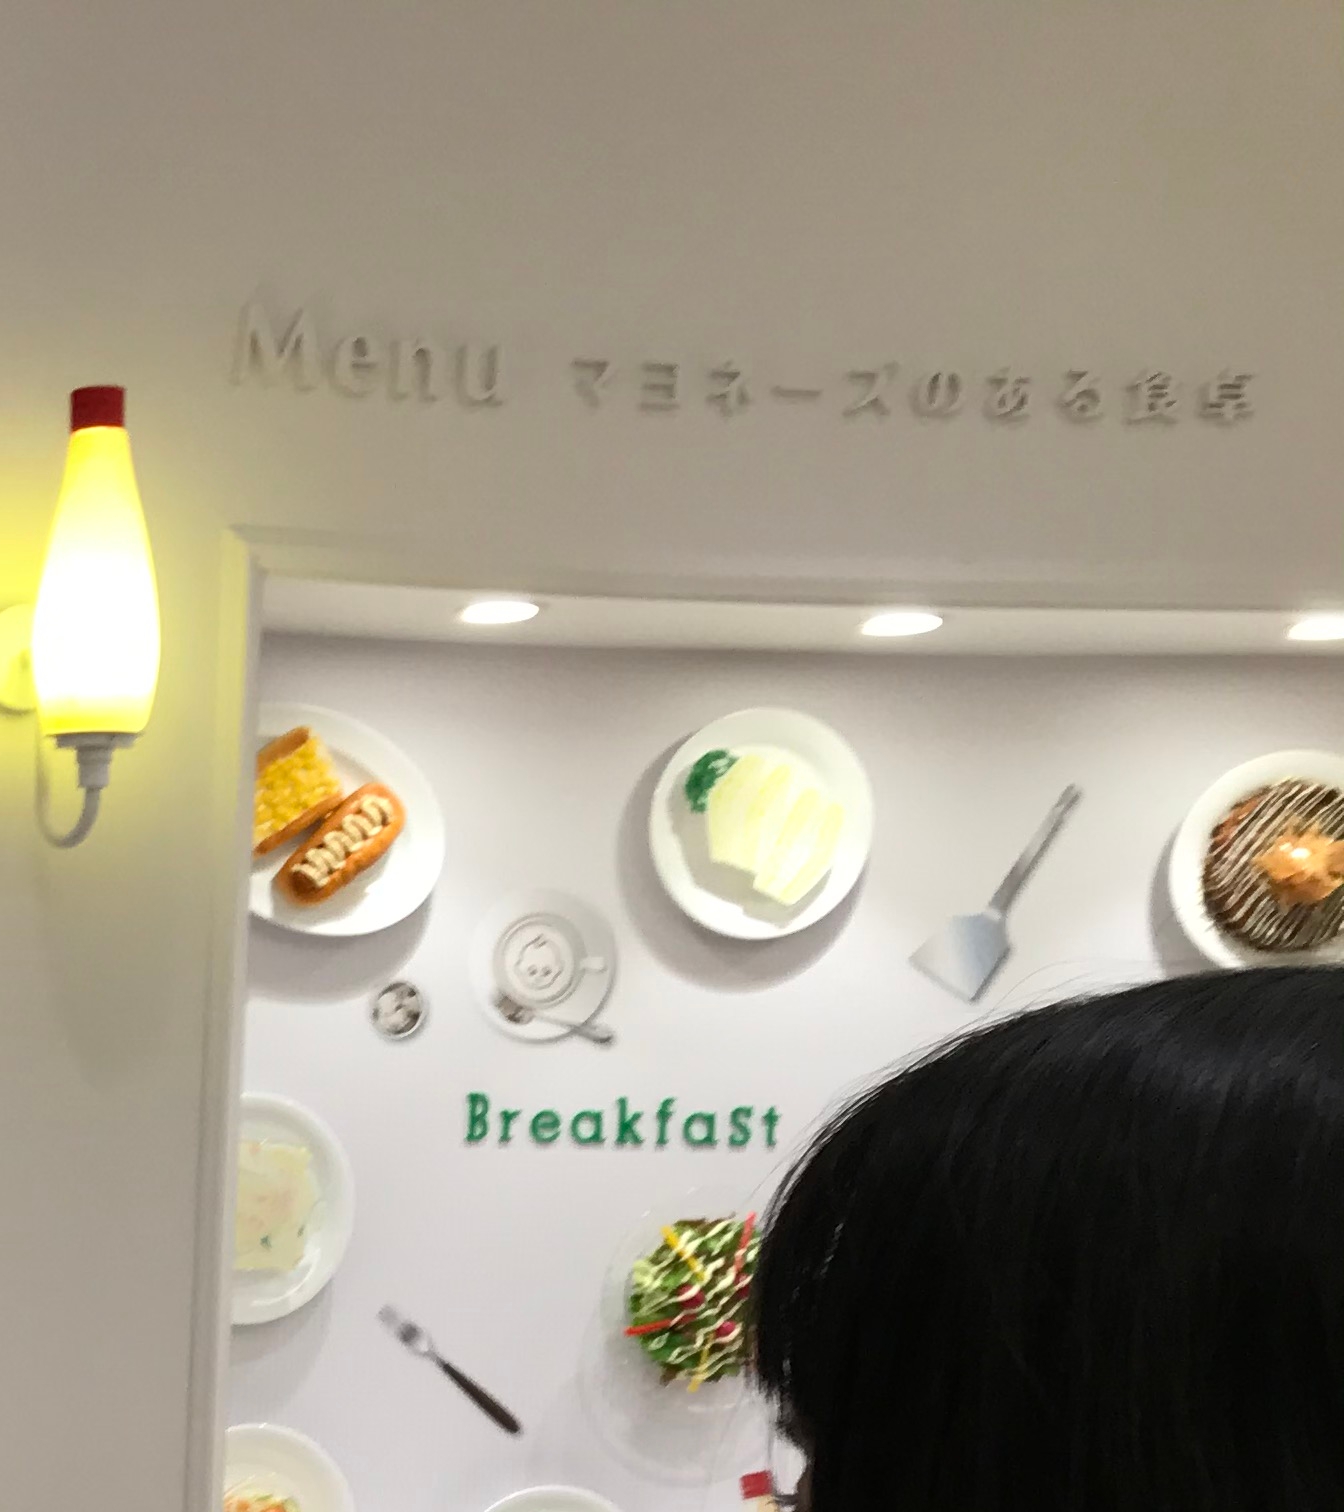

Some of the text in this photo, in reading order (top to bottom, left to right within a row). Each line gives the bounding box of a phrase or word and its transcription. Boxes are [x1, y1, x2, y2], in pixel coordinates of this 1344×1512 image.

[230, 300, 1259, 426] Menu マヨネーズのある食卓
[465, 1092, 781, 1147] Breakfast
